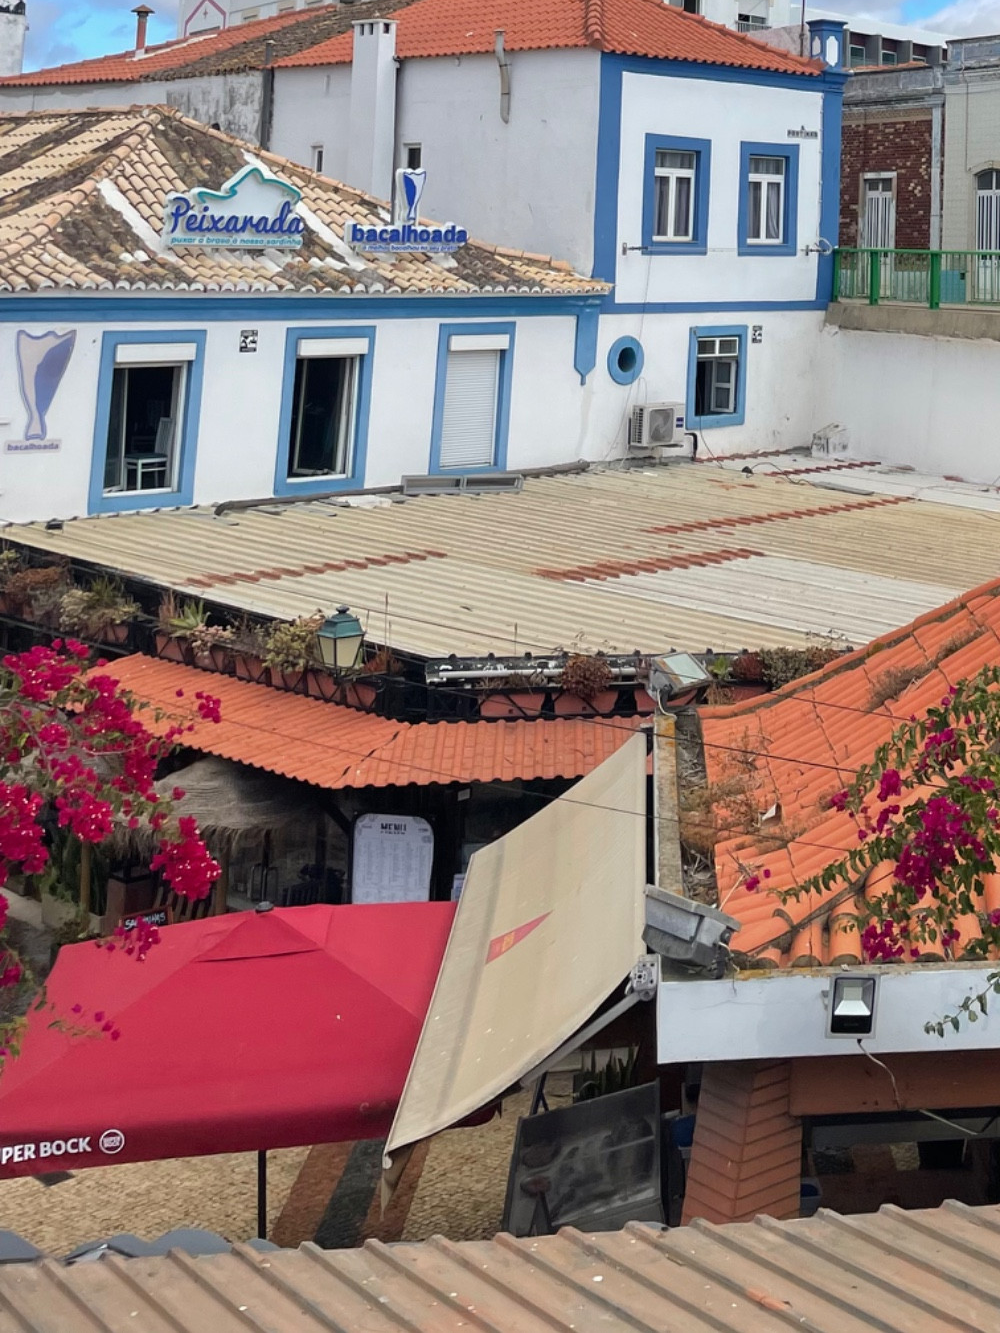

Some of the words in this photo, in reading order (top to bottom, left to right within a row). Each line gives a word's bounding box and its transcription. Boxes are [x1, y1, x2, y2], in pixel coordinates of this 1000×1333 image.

[170, 196, 304, 235] Peixarada
[352, 223, 468, 243] bacalhoada
[7, 443, 59, 451] bacalhoada
[380, 822, 407, 832] MENU
[0, 1143, 36, 1165] PER
[39, 1136, 92, 1158] BOCK
